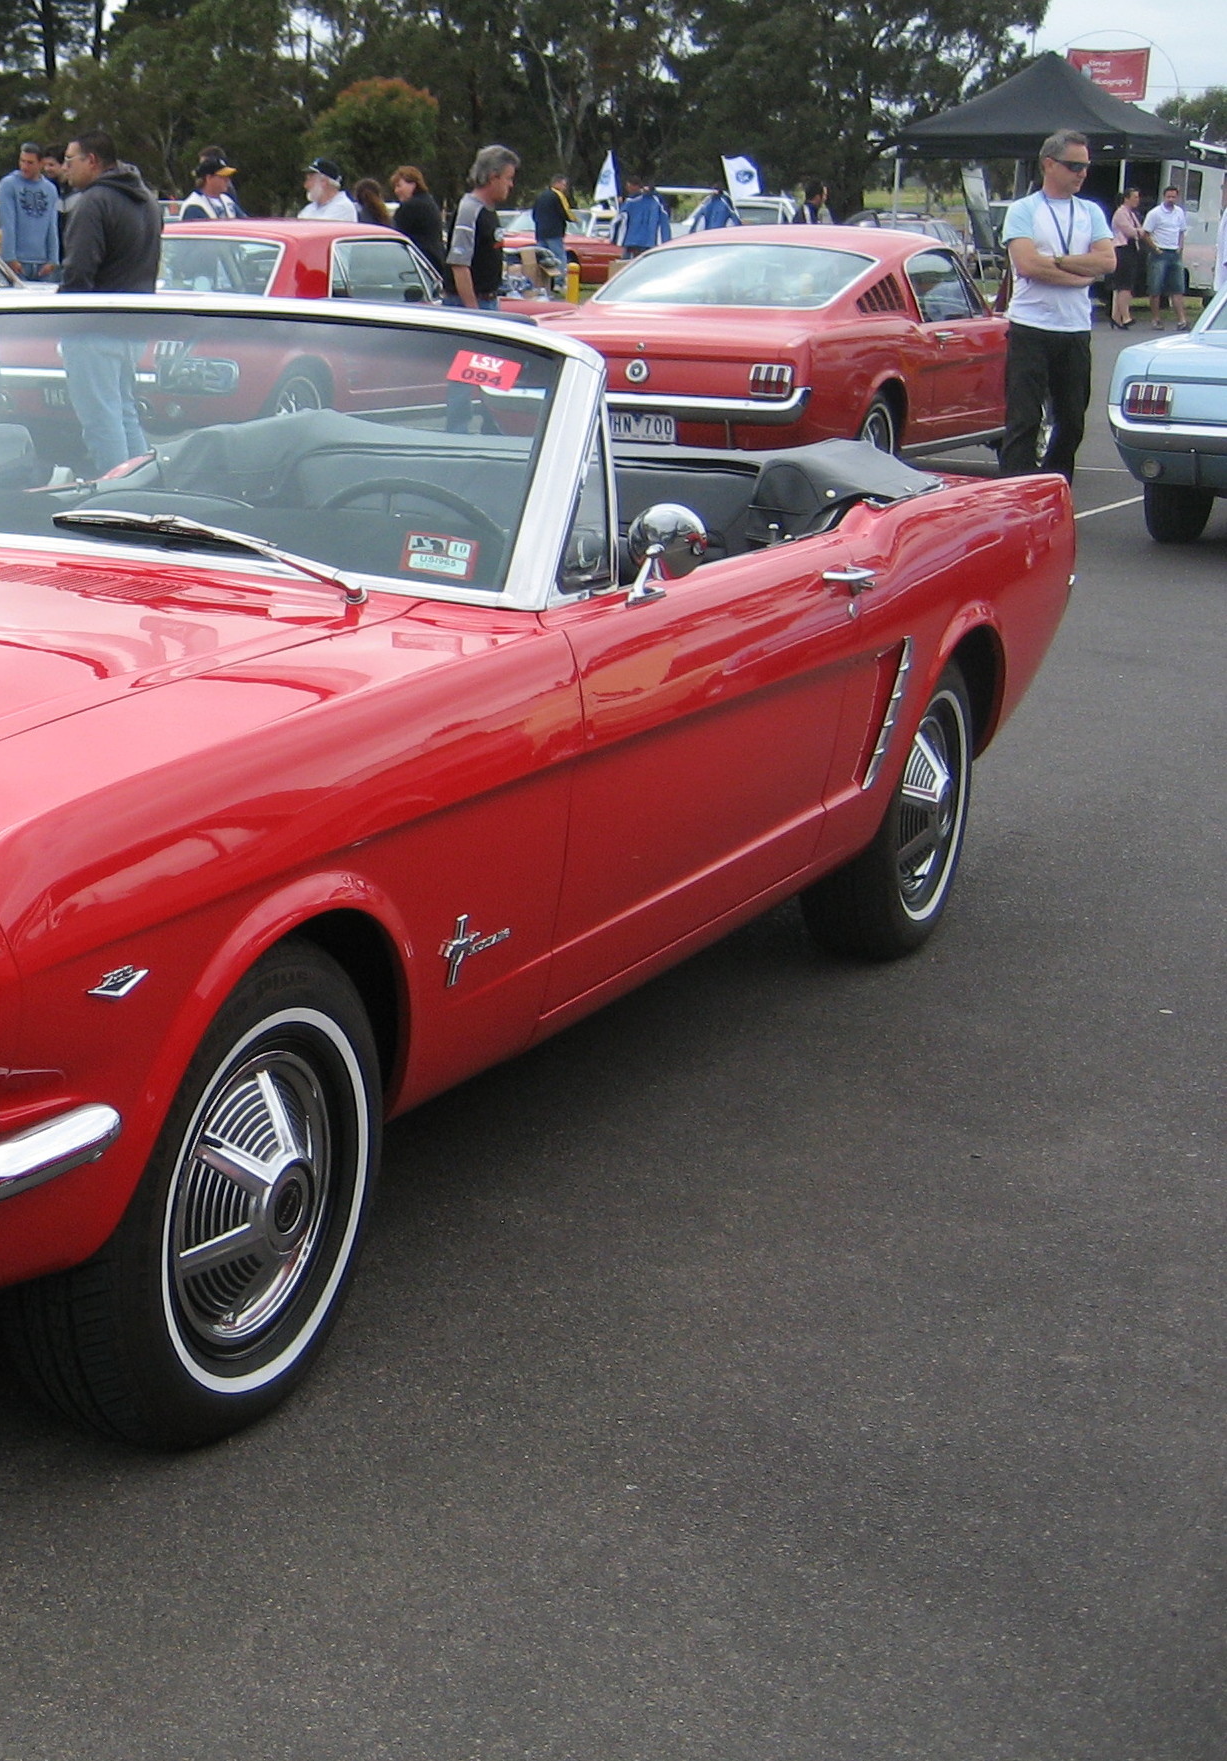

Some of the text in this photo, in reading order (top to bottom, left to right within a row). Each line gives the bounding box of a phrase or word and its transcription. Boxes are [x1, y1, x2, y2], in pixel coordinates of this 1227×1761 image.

[1092, 77, 1134, 88] hotography
[469, 354, 504, 371] LSV
[461, 368, 503, 387] 094
[644, 417, 673, 435] 700
